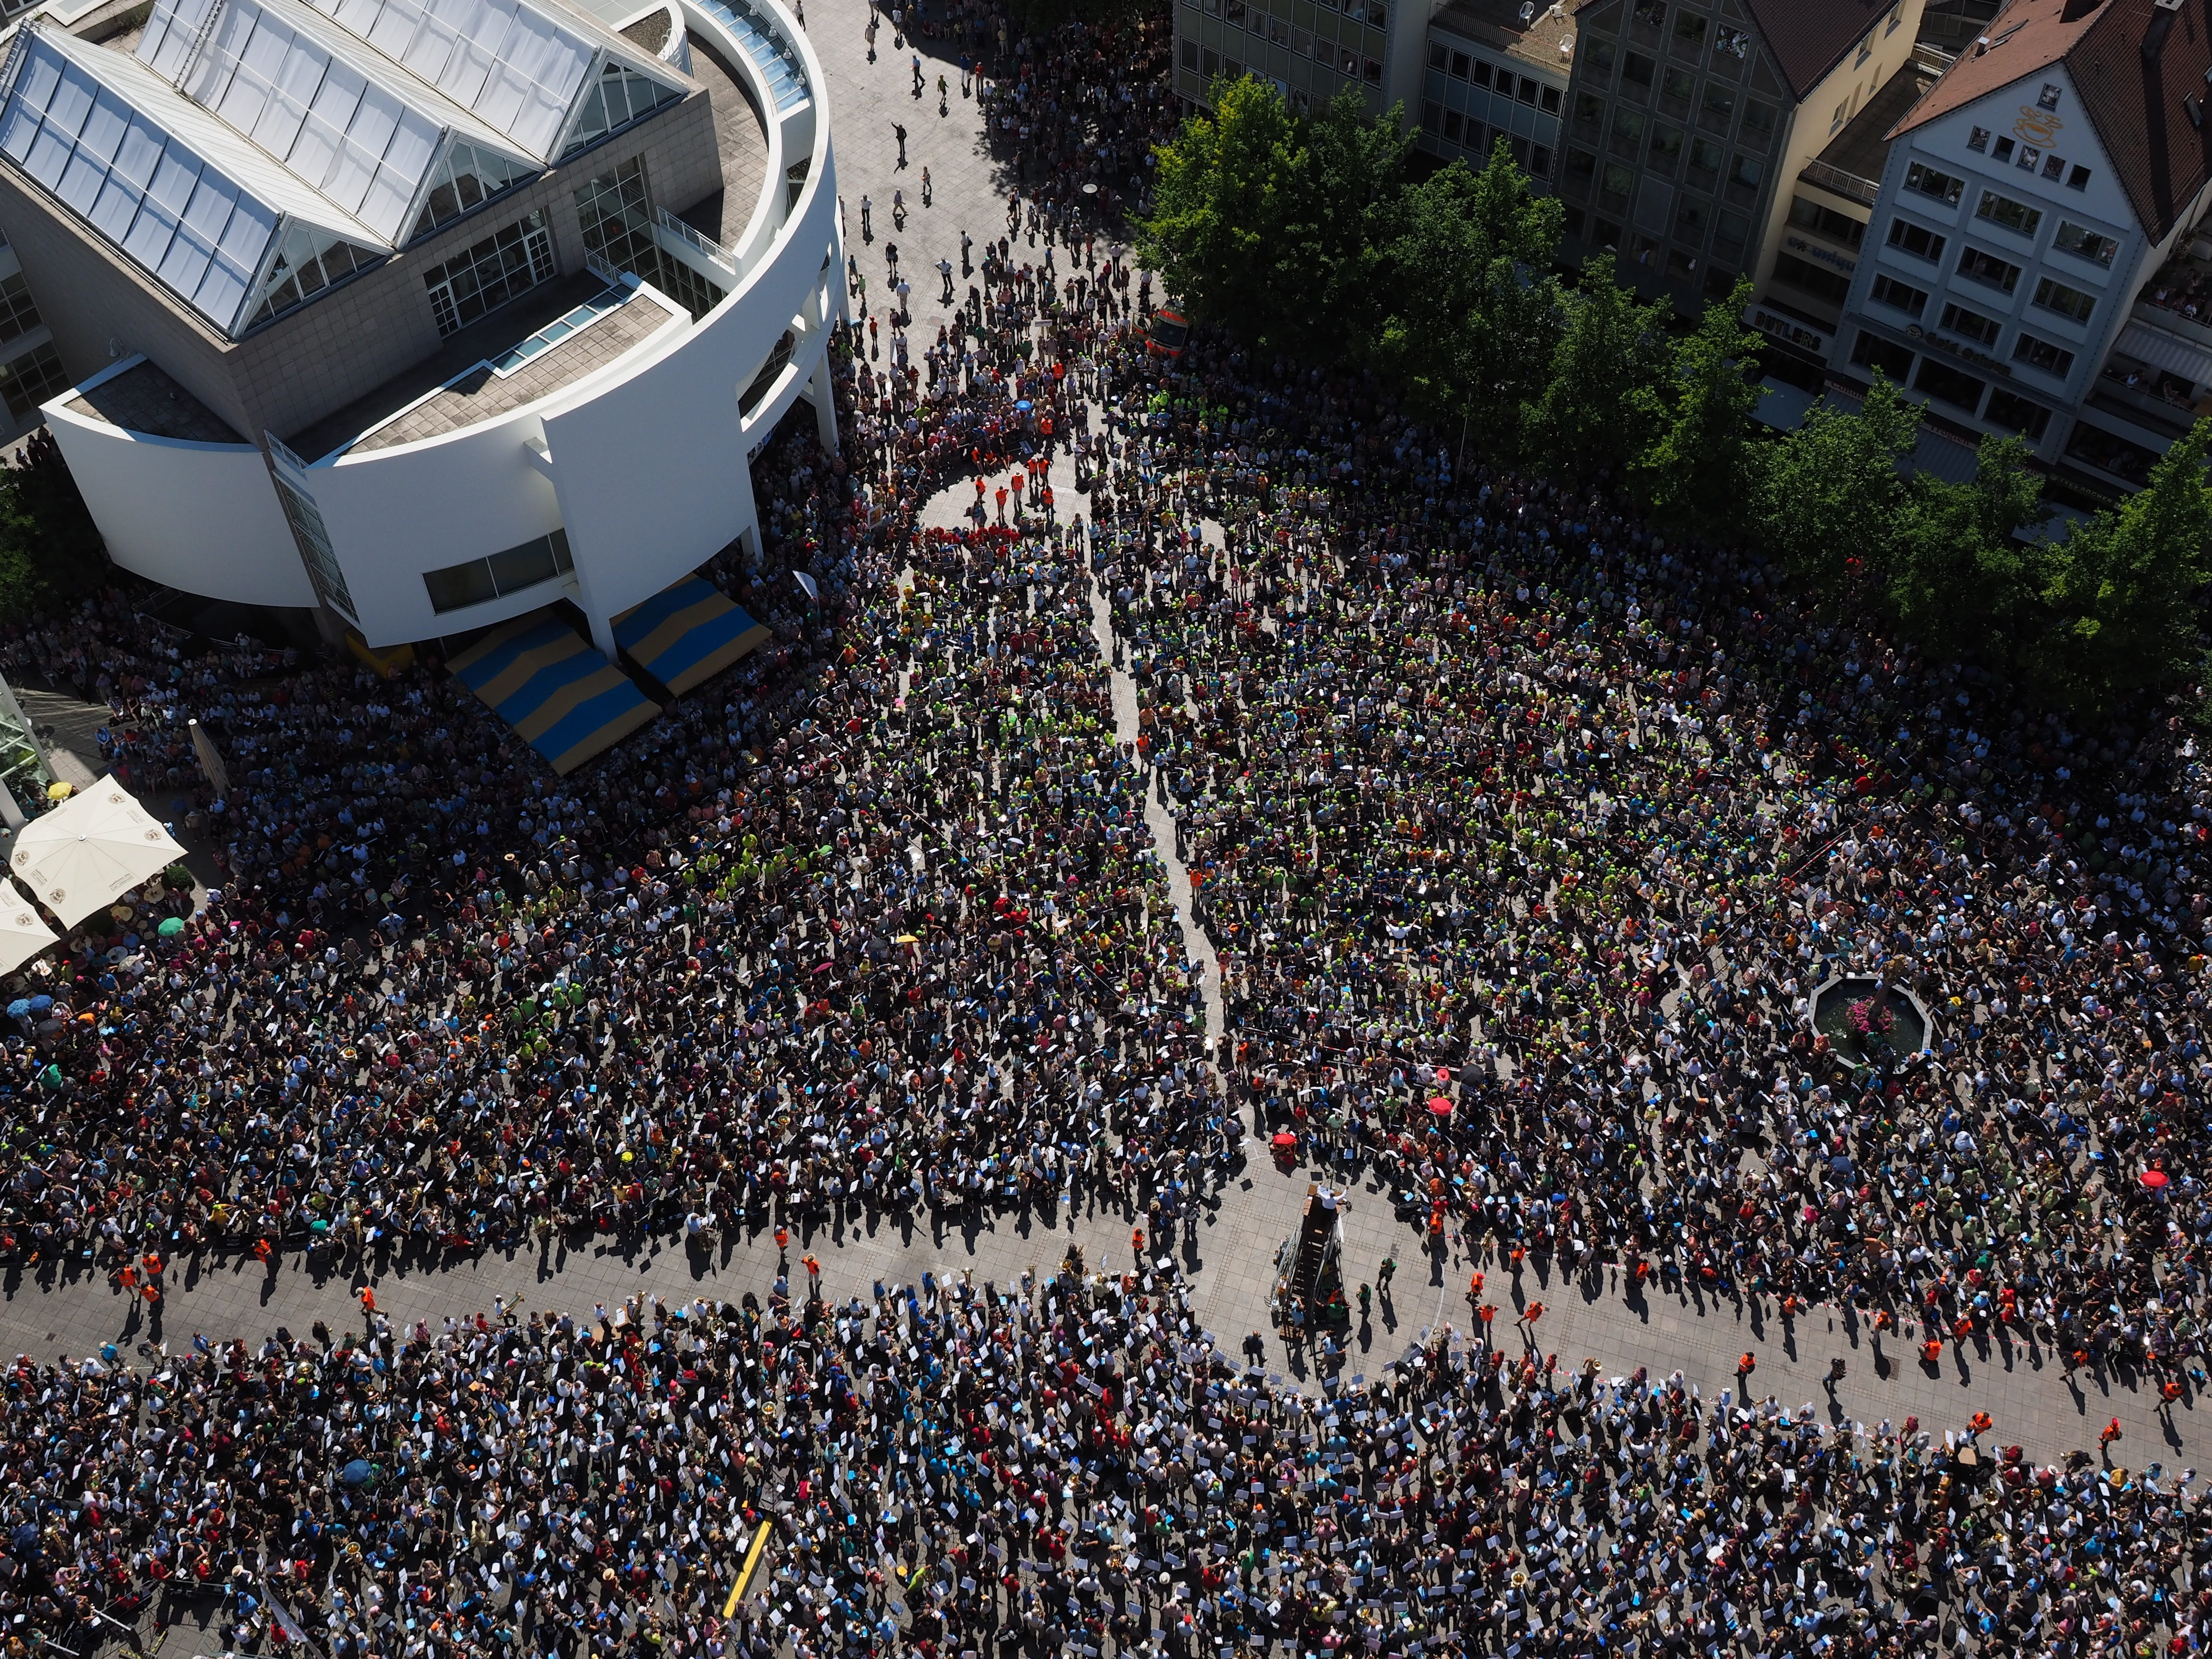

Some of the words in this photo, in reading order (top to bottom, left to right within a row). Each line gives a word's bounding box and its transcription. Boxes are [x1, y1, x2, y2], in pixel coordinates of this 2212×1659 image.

[1755, 311, 1822, 351] BUTLERS
[2060, 477, 2079, 489] YVES
[2080, 486, 2113, 504] ROCHER
